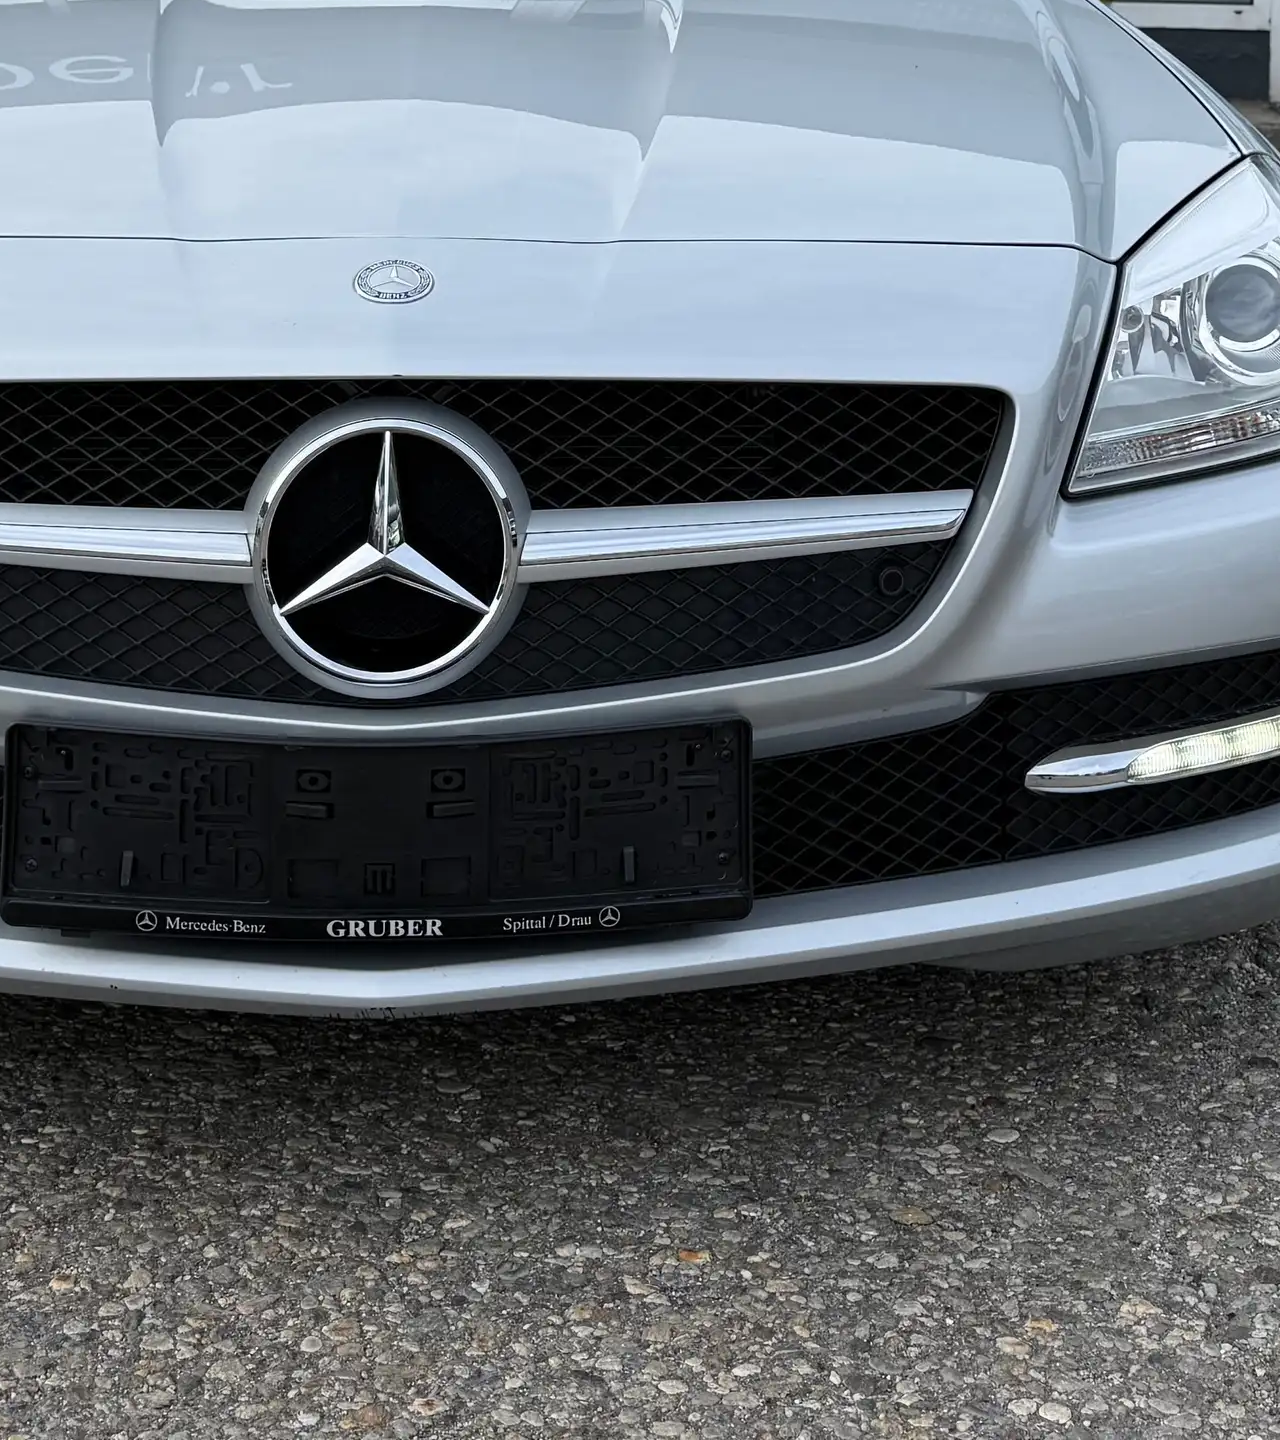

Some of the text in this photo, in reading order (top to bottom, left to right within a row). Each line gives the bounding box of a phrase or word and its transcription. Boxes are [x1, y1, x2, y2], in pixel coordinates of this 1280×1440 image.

[165, 916, 267, 934] Mercedes-Benz
[326, 919, 443, 937] GRUBER
[502, 916, 547, 932] Spittal
[558, 914, 592, 929] Drau
